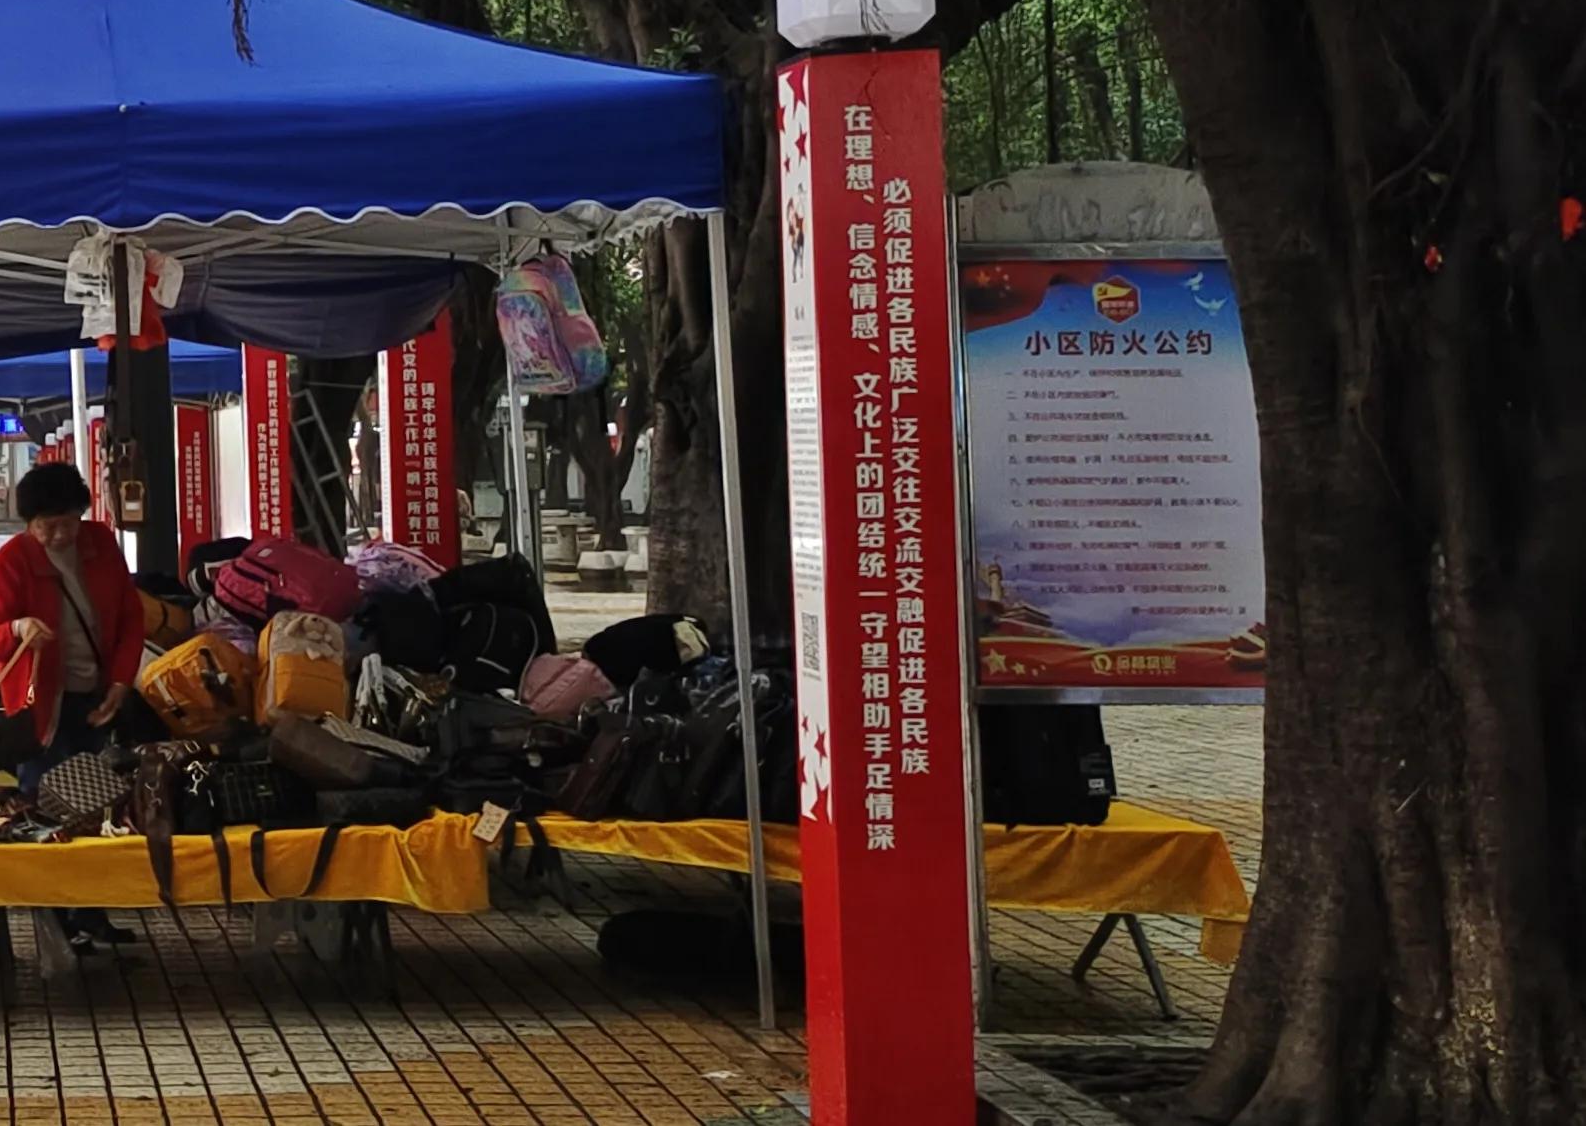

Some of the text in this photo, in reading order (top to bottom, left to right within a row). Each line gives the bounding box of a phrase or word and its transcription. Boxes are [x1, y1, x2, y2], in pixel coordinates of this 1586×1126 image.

[844, 105, 896, 851] 在理想、信念情感、文化上的团结统一守望相助手足情深
[883, 178, 930, 774] 必须促进各民族广泛交往交流交融促进各民族
[1025, 330, 1212, 356] 小区防火公约
